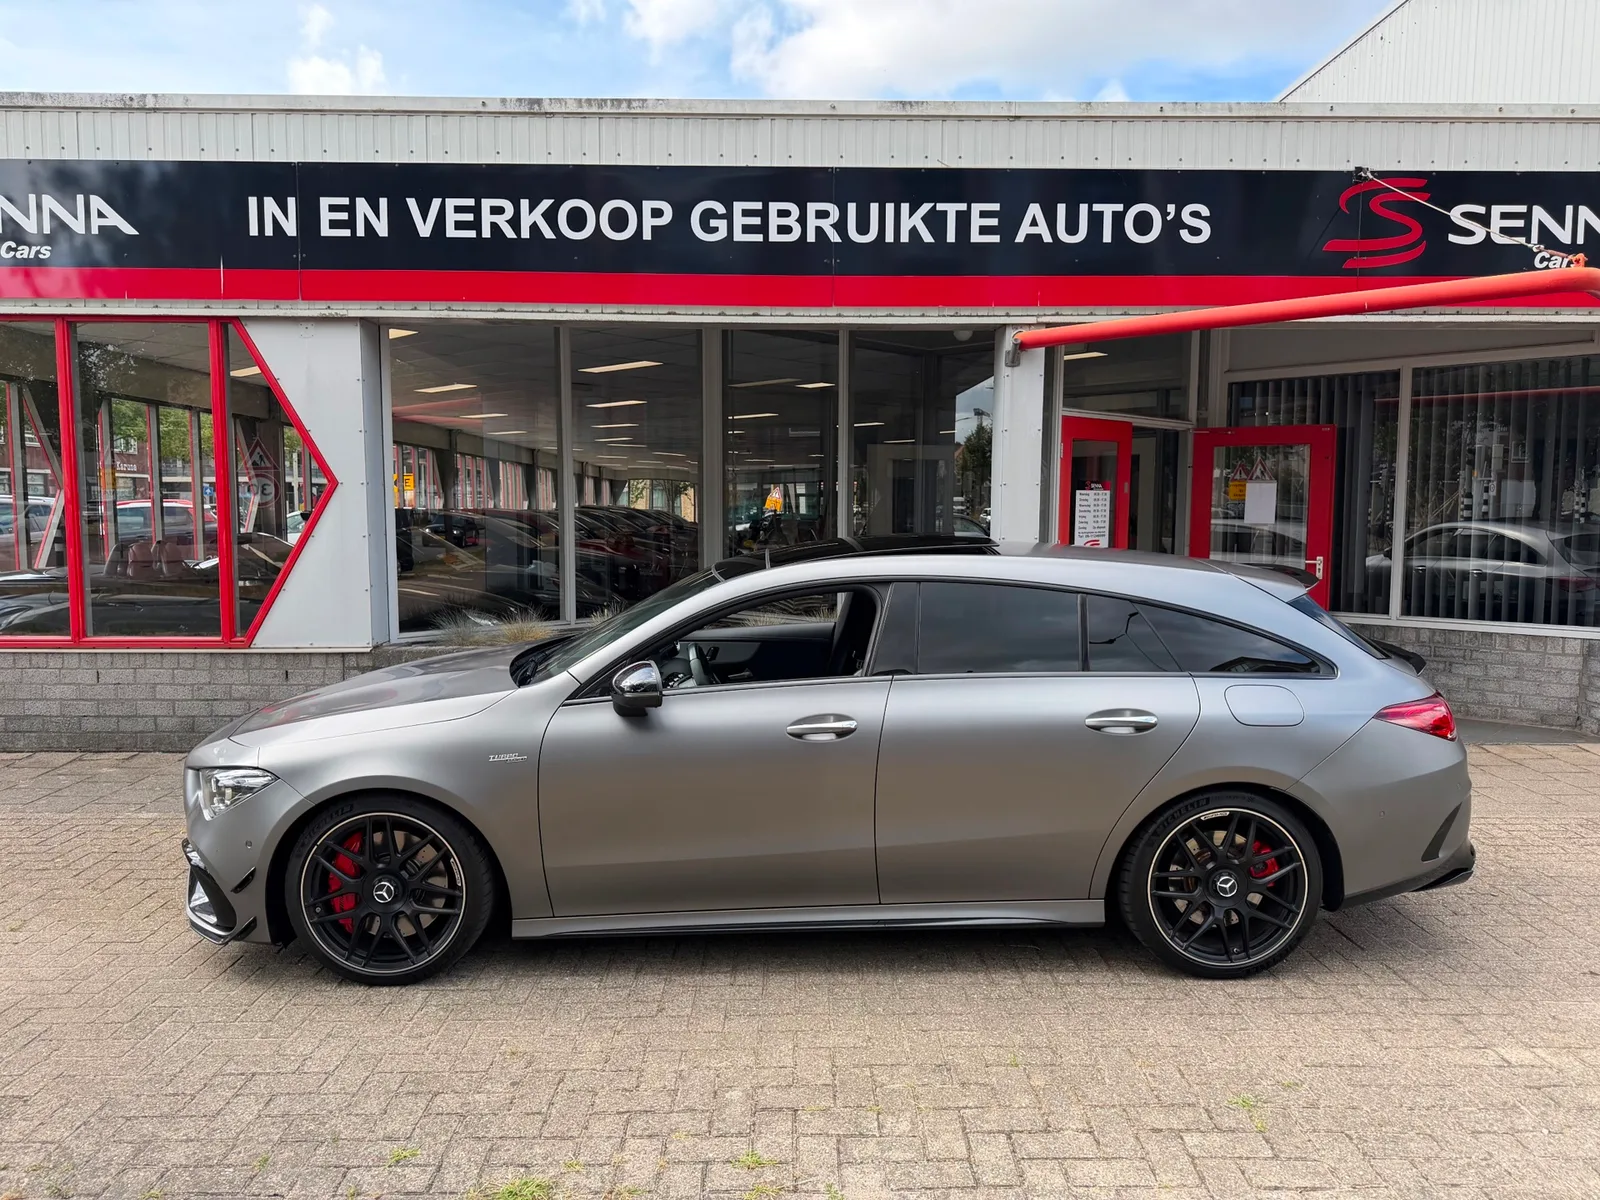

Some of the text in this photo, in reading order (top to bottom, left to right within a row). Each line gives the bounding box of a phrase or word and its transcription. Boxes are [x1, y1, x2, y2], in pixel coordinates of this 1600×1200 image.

[248, 196, 297, 237] IN
[319, 196, 389, 237] EN
[406, 198, 673, 241] VERKOOP
[690, 199, 1001, 243] GEBRUIKTE
[0, 241, 51, 259] Cars
[1534, 252, 1576, 269] Car
